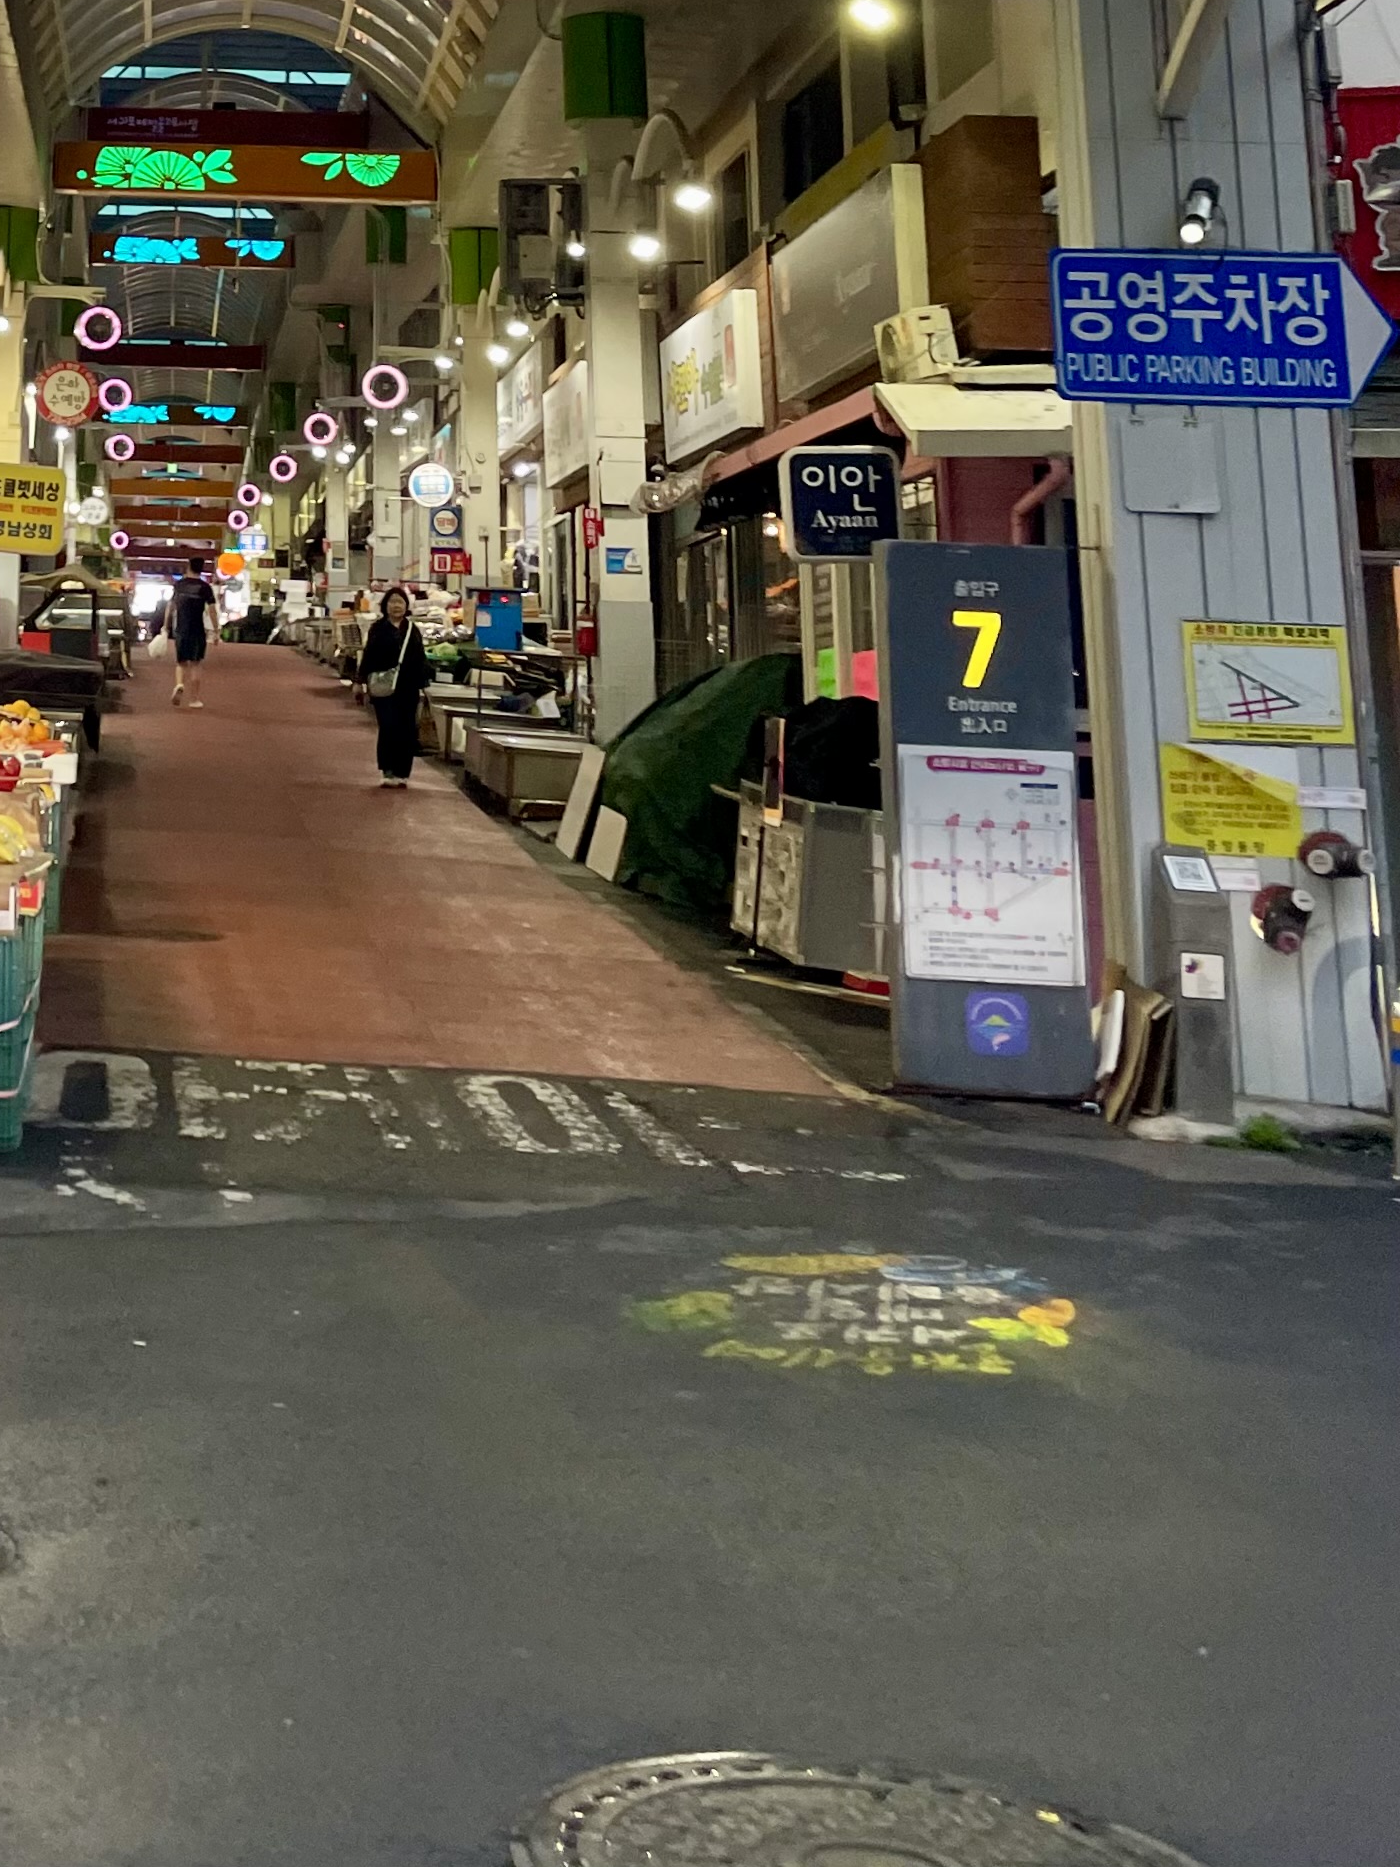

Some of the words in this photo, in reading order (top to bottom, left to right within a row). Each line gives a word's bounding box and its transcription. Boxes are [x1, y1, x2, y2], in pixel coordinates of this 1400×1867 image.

[1063, 270, 1331, 346] 공영주차장
[1066, 352, 1139, 382] PUBLIC
[1145, 355, 1235, 385] PARKING
[1241, 357, 1338, 388] BUILDING
[801, 464, 883, 512] 이안
[811, 509, 880, 534] Ayaan
[954, 579, 1000, 598] 출입구
[952, 610, 1002, 688] 7
[947, 696, 1018, 714] Entrance
